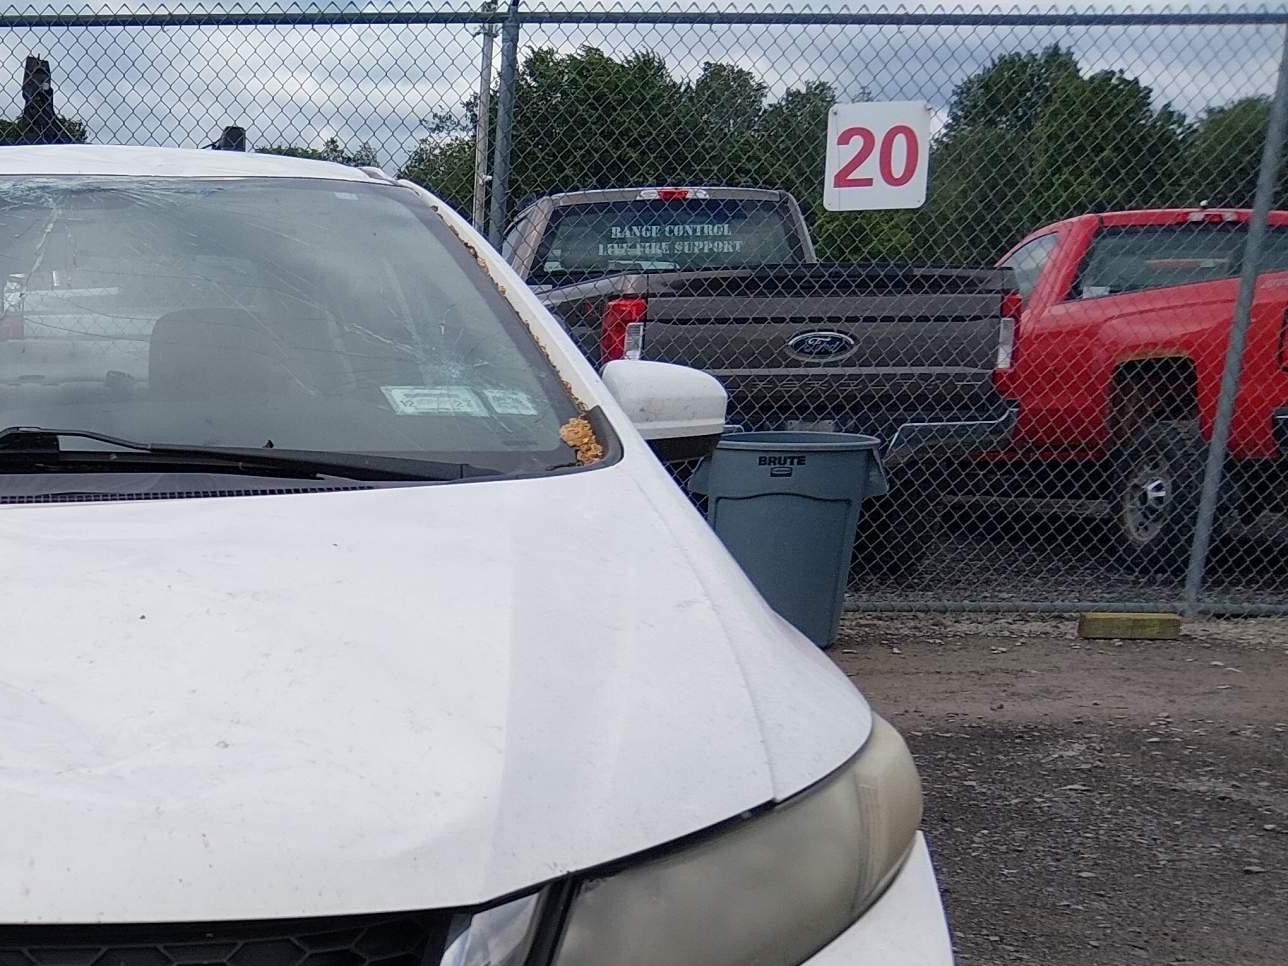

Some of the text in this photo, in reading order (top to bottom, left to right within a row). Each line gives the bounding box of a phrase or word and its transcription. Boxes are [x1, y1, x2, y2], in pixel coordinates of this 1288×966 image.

[833, 124, 919, 188] 20
[611, 223, 732, 239] RANGE CONTROL
[674, 240, 744, 254] SUPPORT
[758, 455, 807, 466] BRUTE
